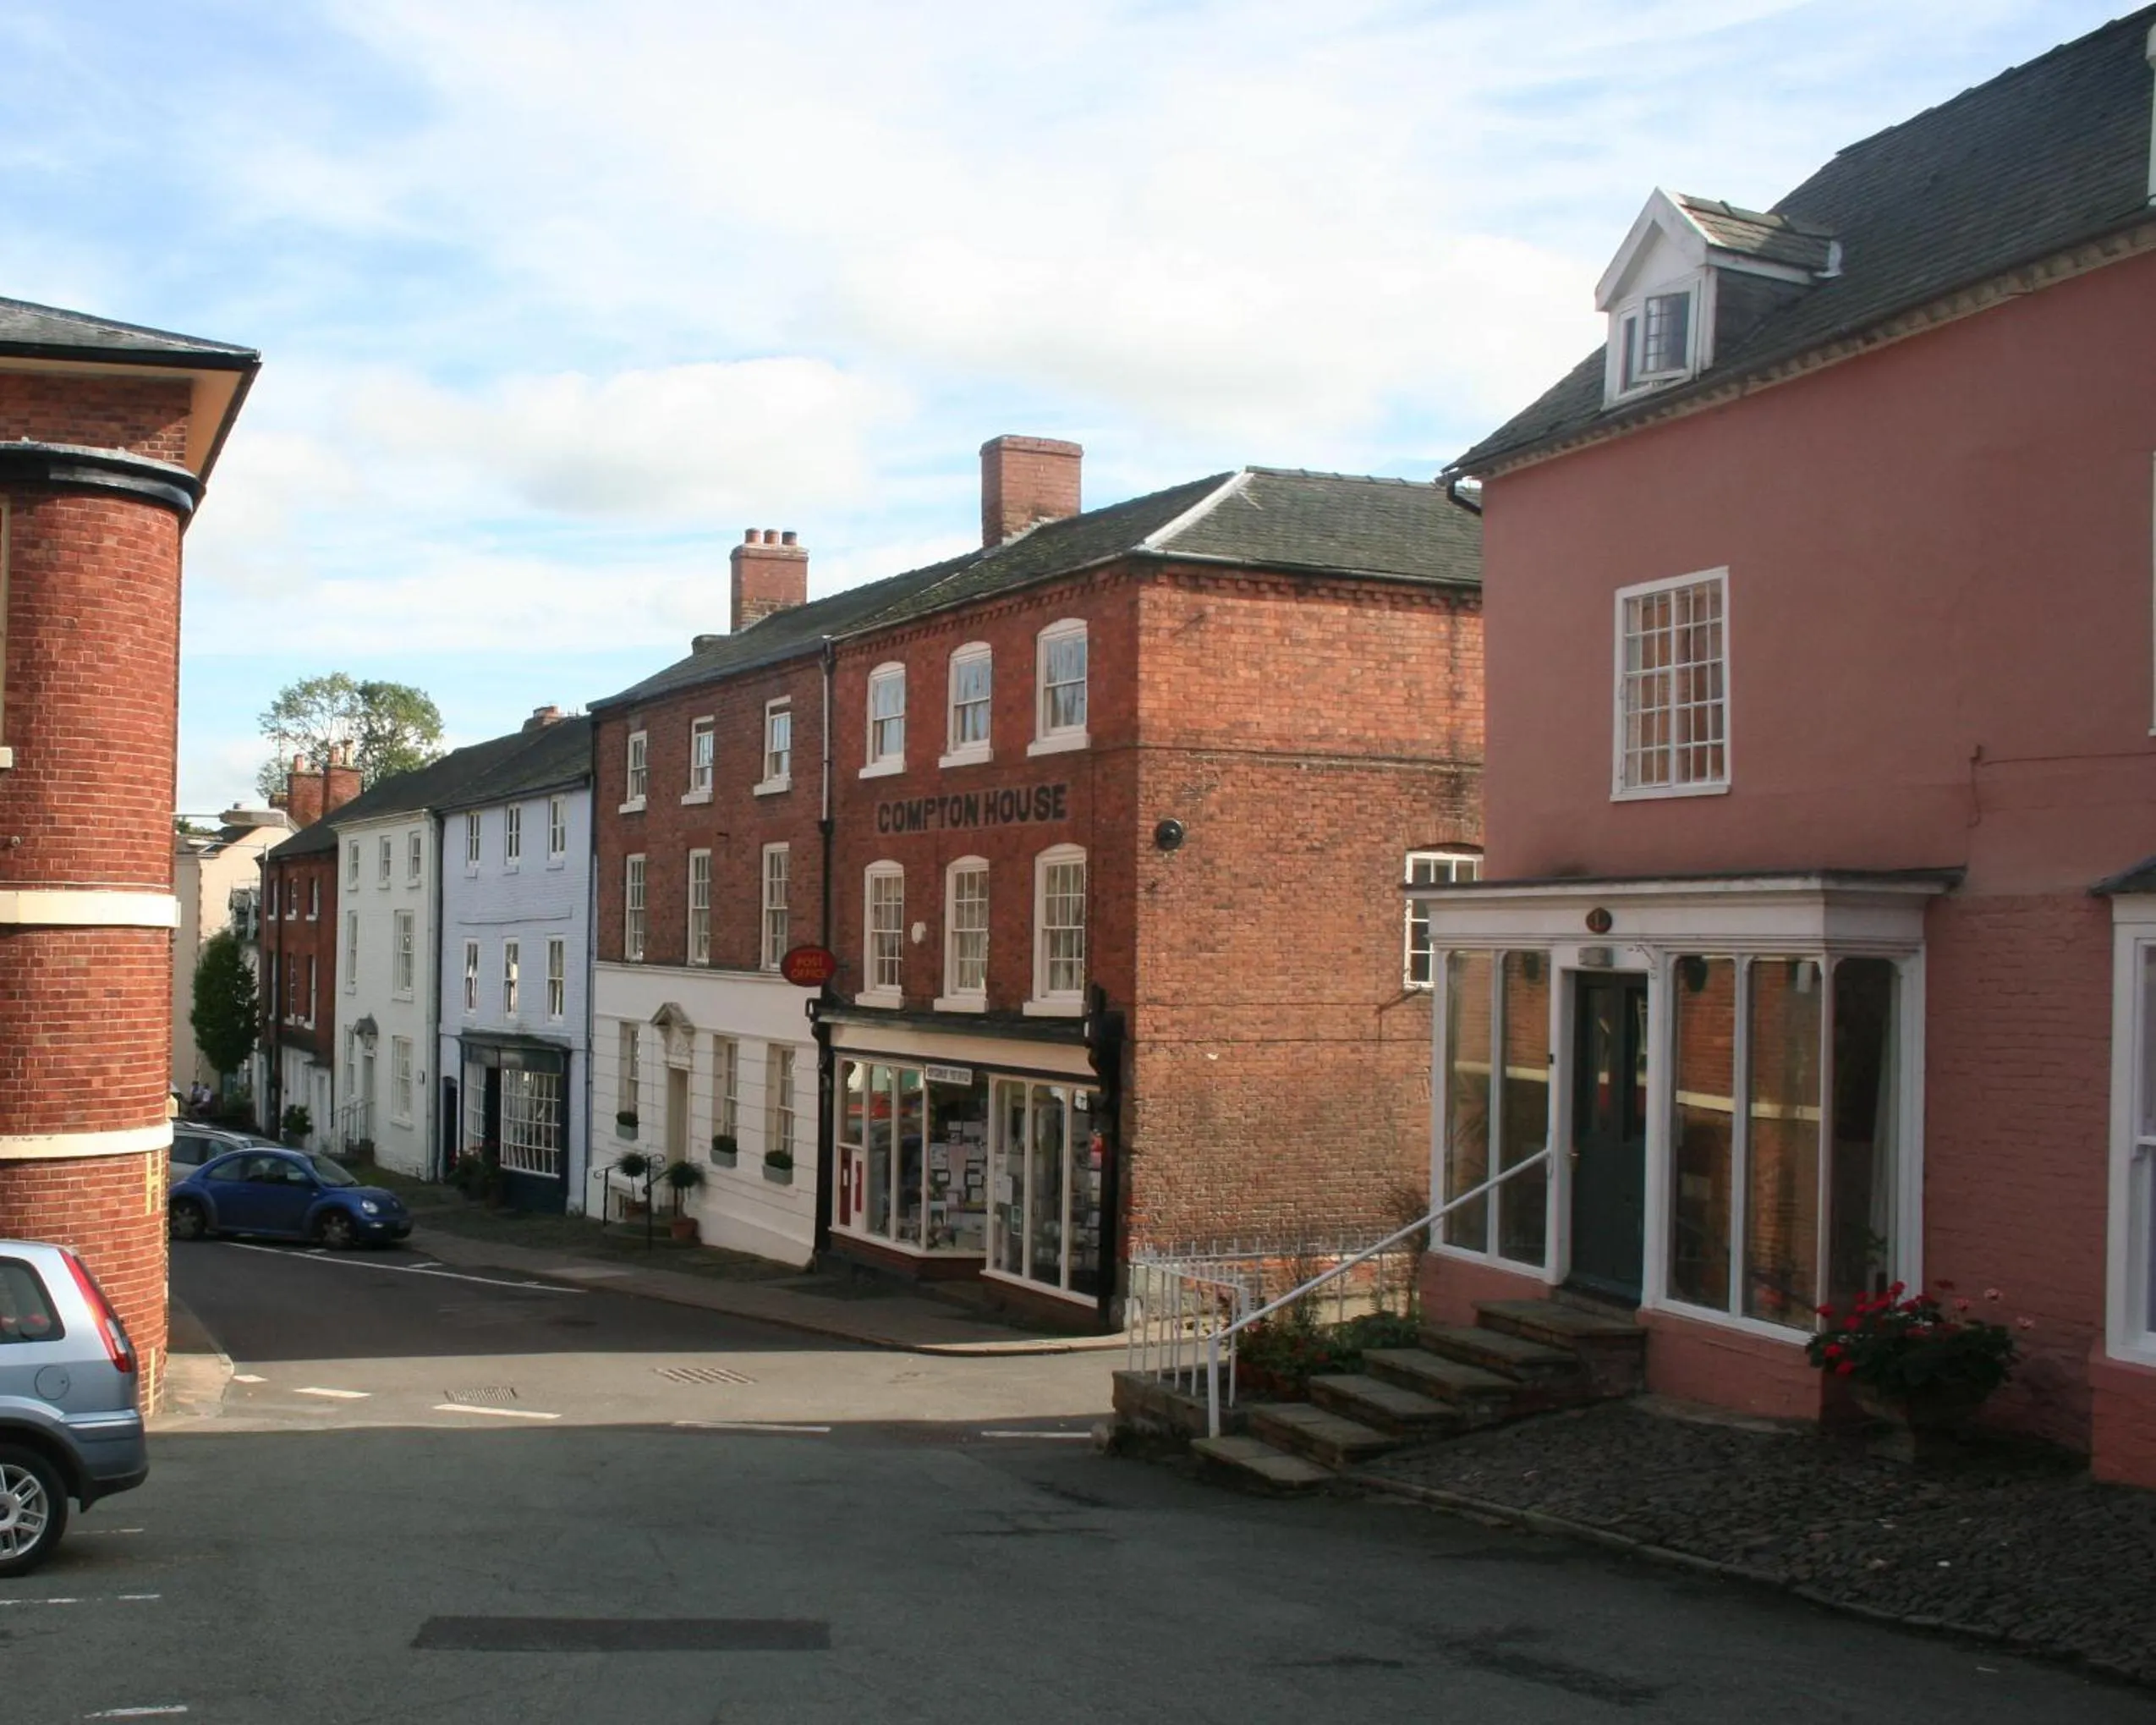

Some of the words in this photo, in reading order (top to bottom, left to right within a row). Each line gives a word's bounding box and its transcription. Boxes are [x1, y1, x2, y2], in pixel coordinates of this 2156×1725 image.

[877, 794, 979, 833] COMPTON
[984, 783, 1067, 826] HOUSE
[796, 953, 823, 968] POST
